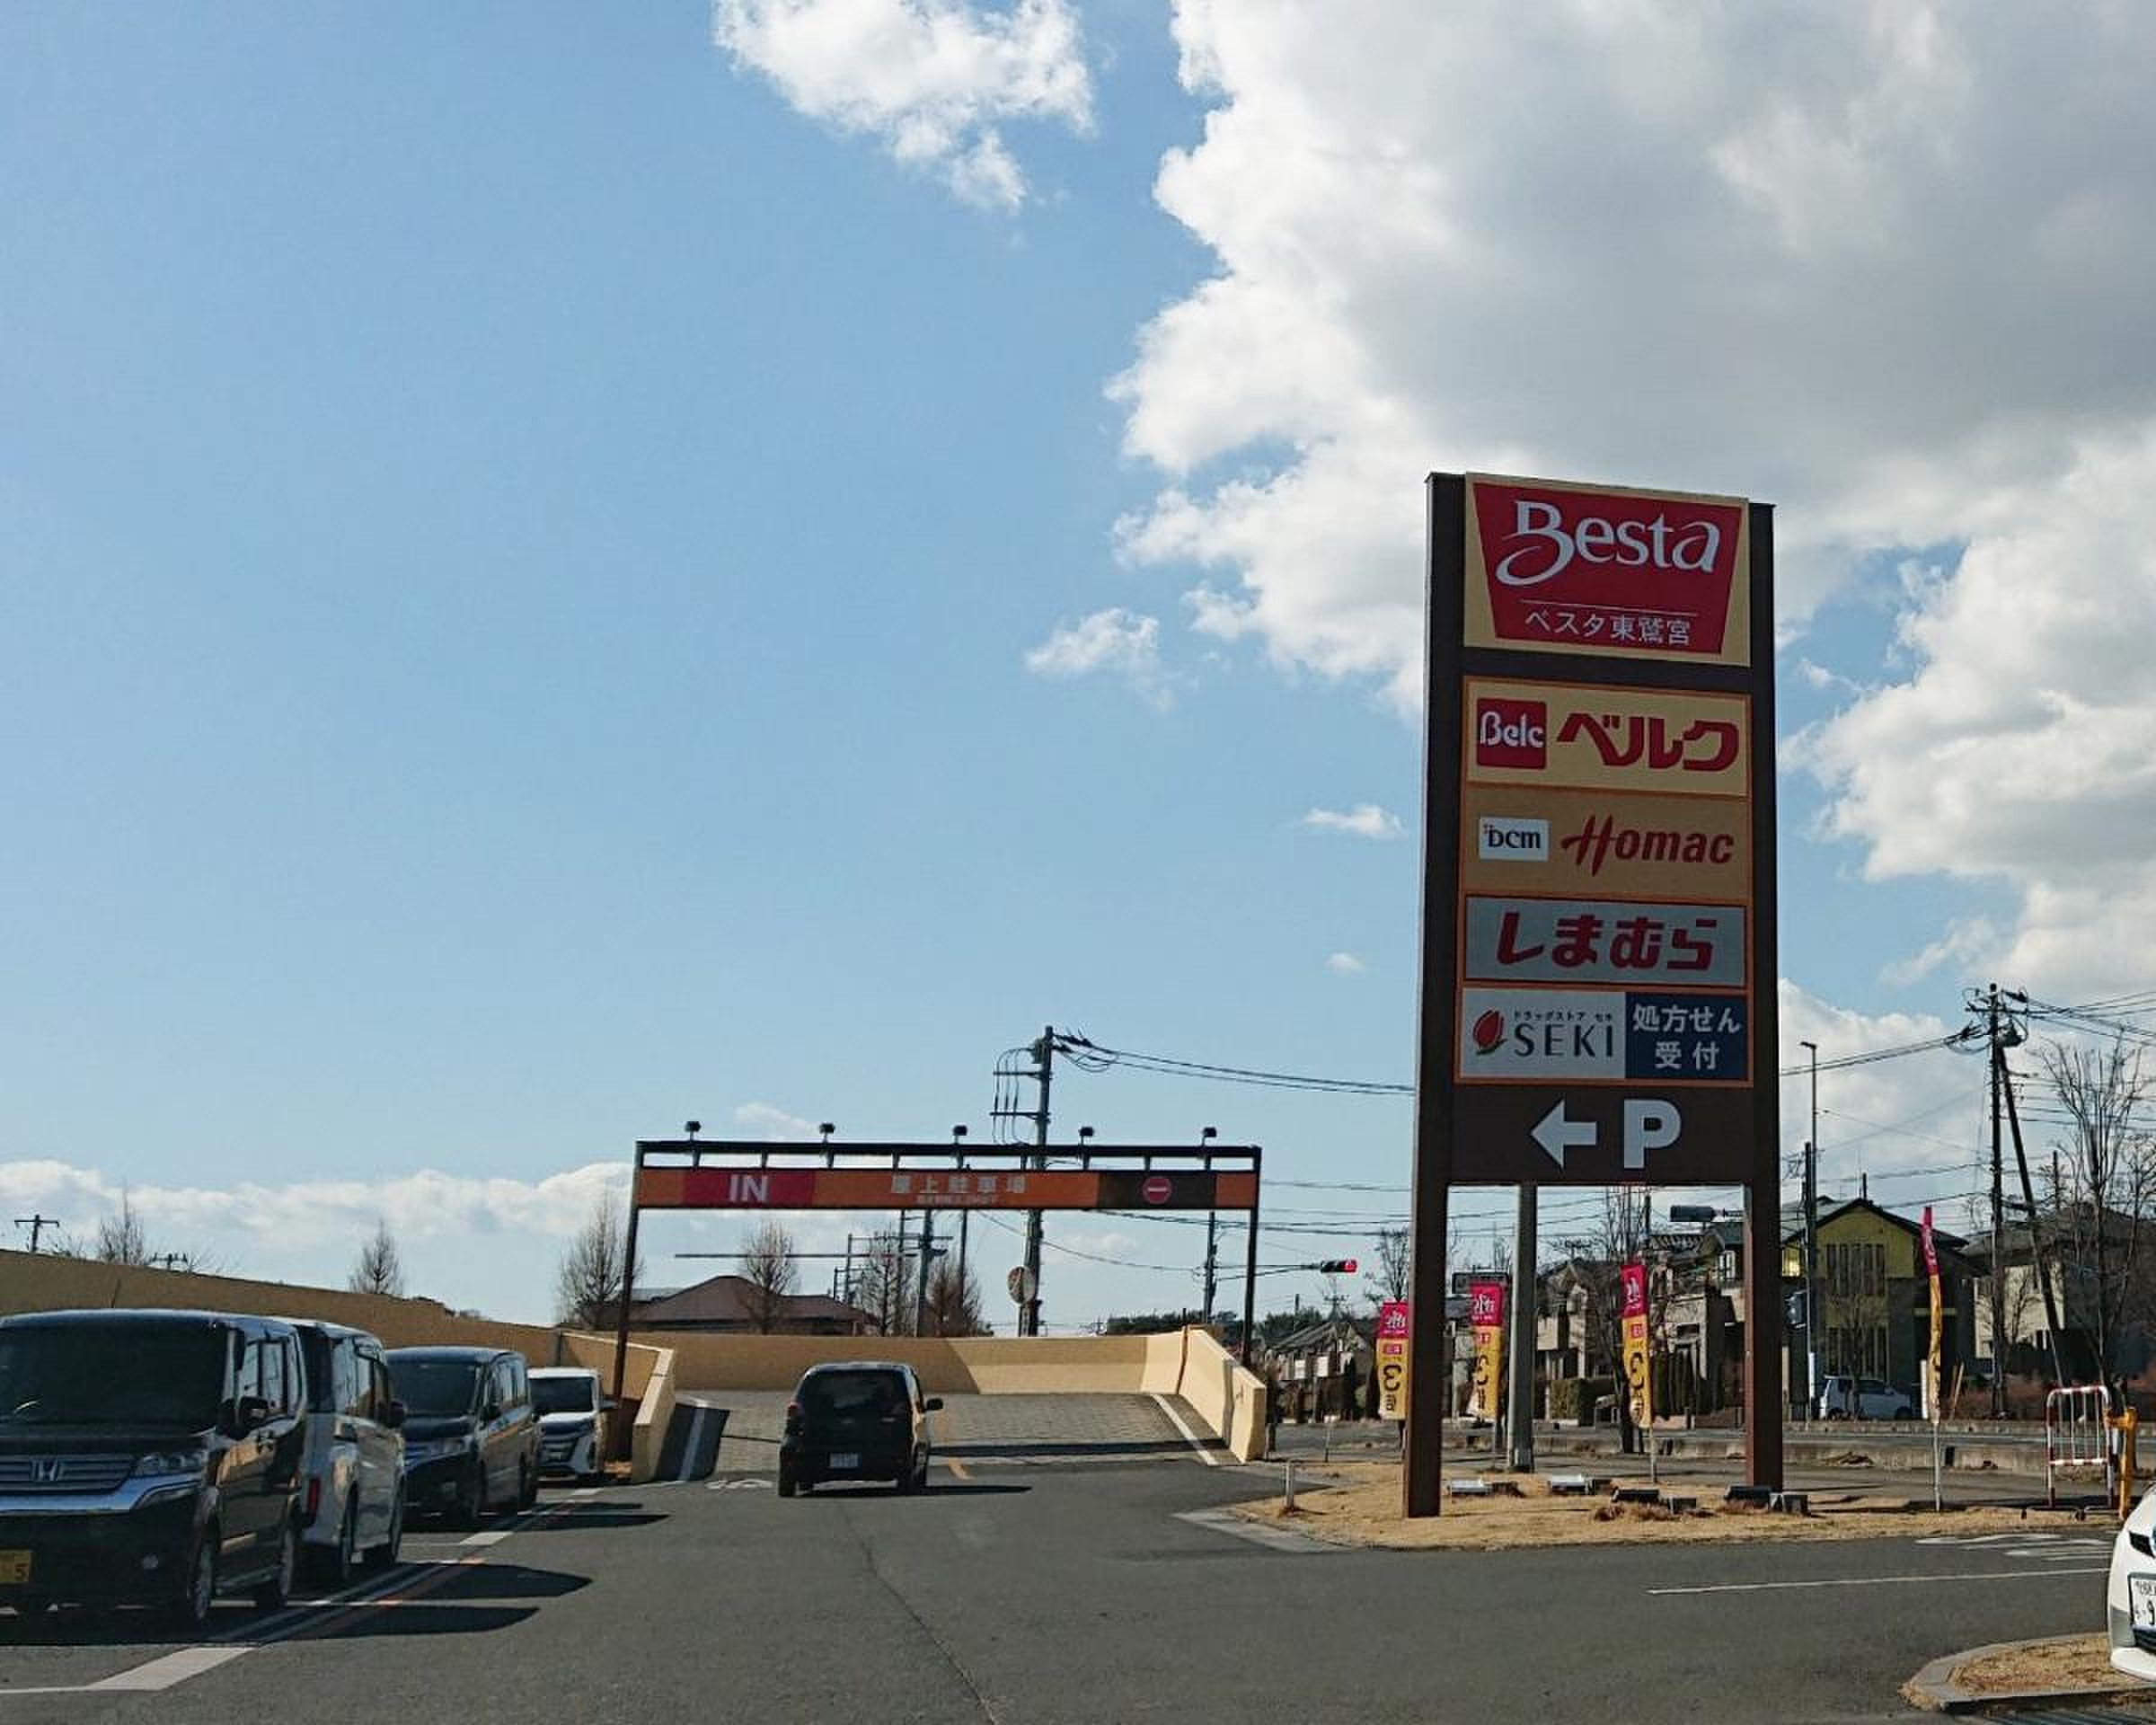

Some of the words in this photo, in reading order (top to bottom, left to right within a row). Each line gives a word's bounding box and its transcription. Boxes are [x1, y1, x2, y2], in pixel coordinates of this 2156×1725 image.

[1496, 500, 1720, 586] Besta
[1524, 611, 1692, 647] ベスタ東鷲宮
[1480, 711, 1545, 748] Belc
[1556, 712, 1739, 772] ベルク
[1561, 815, 1735, 877] Homac
[1495, 912, 1718, 970] しまむら
[1632, 1004, 1743, 1034] 処方せん
[1514, 1022, 1613, 1057] SEKI
[1654, 1040, 1720, 1070] 受付
[1623, 1099, 1682, 1169] P
[729, 1173, 770, 1203] IN
